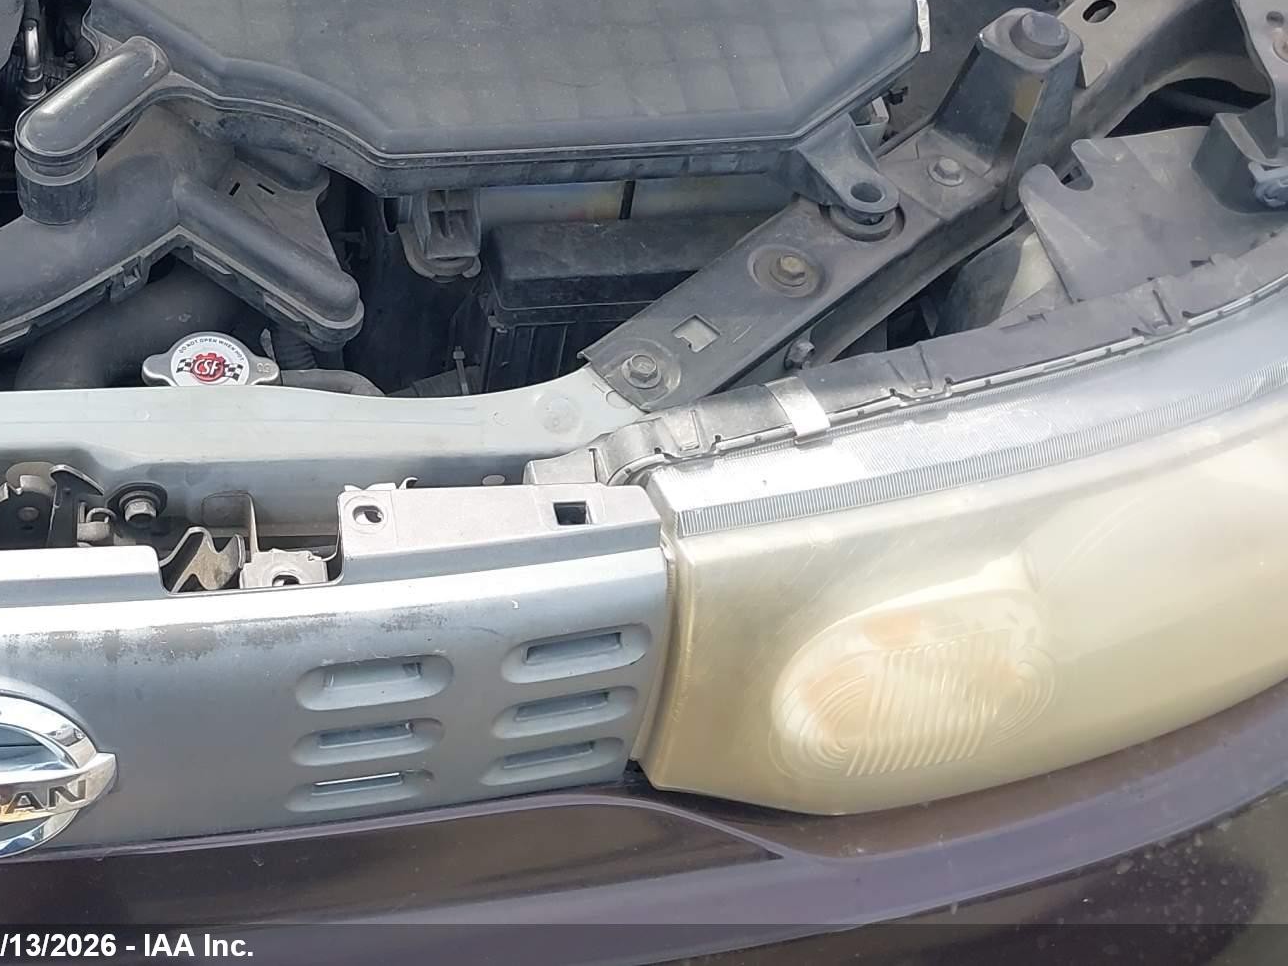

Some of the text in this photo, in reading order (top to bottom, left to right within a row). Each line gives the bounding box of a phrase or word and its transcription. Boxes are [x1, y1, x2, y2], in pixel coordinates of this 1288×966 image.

[186, 339, 199, 347] NOT
[218, 339, 236, 351] WHEN
[193, 358, 220, 376] CSF
